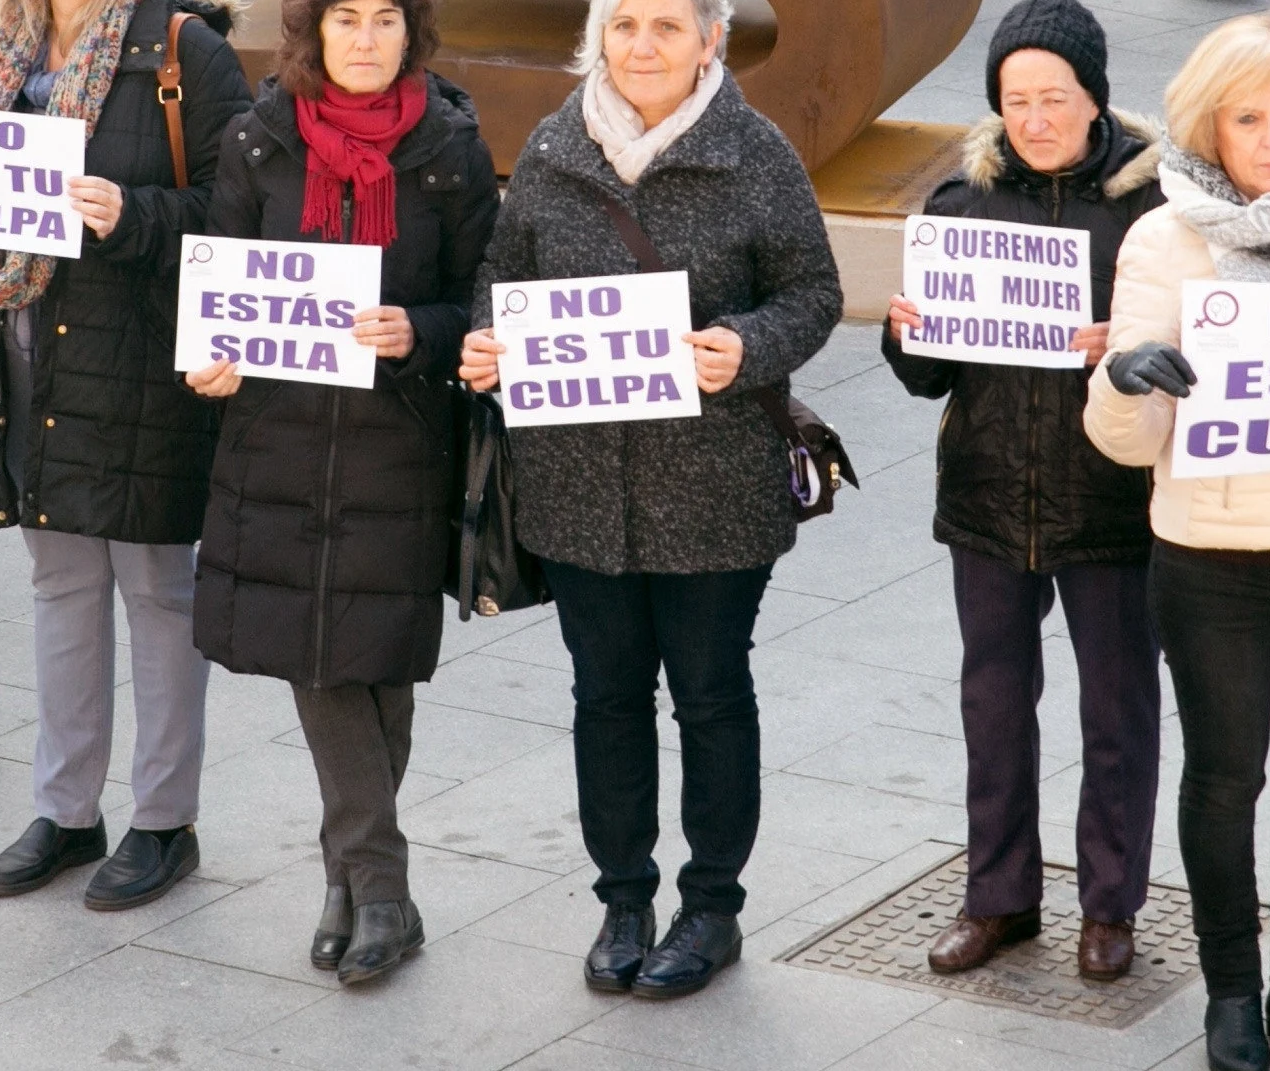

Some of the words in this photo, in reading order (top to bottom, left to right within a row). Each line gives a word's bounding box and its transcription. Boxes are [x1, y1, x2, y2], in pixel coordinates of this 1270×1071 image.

[4, 164, 63, 197] TU
[246, 249, 315, 282] NO
[943, 227, 1078, 268] QUEREMOS
[200, 290, 356, 329] ESTÁS
[550, 286, 622, 319] NO
[924, 270, 976, 302] UNA
[1002, 275, 1080, 312] MUJER
[210, 334, 339, 373] SOLA
[525, 334, 588, 365] ES
[600, 328, 670, 360] TU
[509, 373, 682, 410] CULPA
